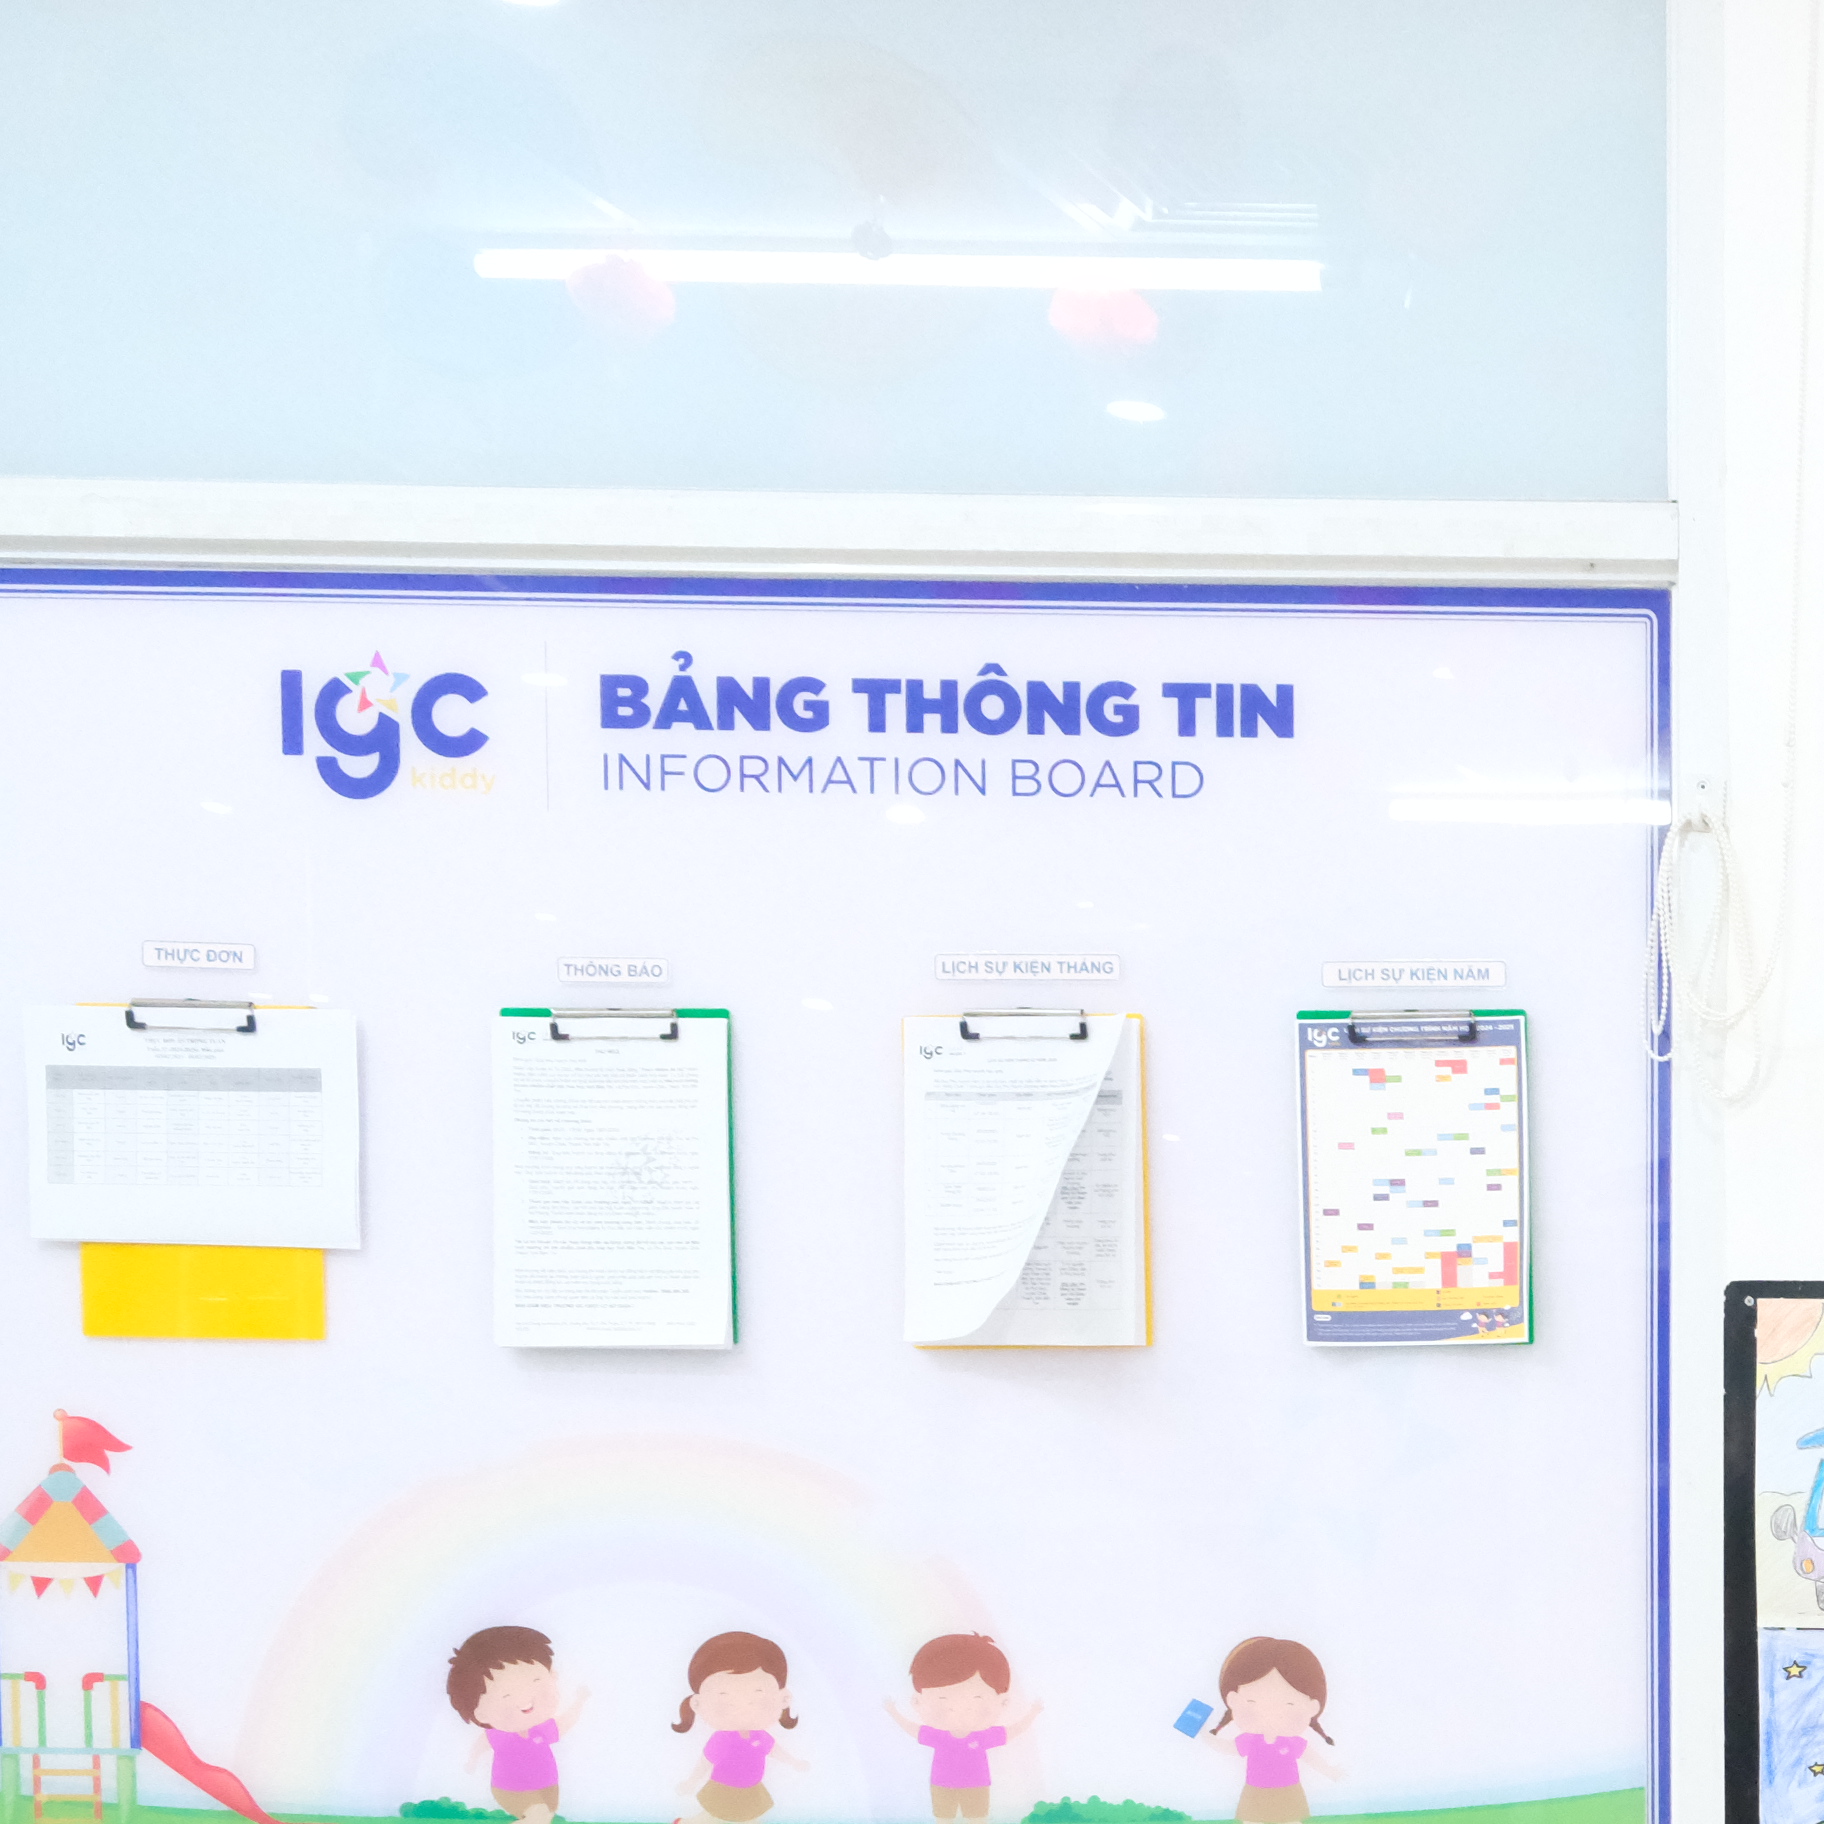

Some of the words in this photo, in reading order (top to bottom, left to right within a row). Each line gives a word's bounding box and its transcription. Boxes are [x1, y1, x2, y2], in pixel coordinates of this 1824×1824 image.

[599, 650, 830, 734] BẢNG
[851, 662, 1141, 737] THÔNG
[1161, 681, 1295, 739] TIN
[602, 753, 987, 797] INFORMATION
[1010, 758, 1205, 799] BOARD
[154, 946, 201, 964] THỰC
[205, 948, 244, 964] ĐƠN
[563, 961, 623, 978] THÔNG
[626, 963, 663, 978] BÁO
[941, 960, 980, 977] LỊCH
[983, 960, 1009, 976] SỰ
[1012, 960, 1052, 977] KIỆN
[1056, 957, 1114, 975] THÁNG
[1337, 967, 1376, 984] LỊCH
[1380, 967, 1406, 984] SỰ
[1409, 966, 1449, 983] KIỆN
[1452, 967, 1490, 982] NĂM
